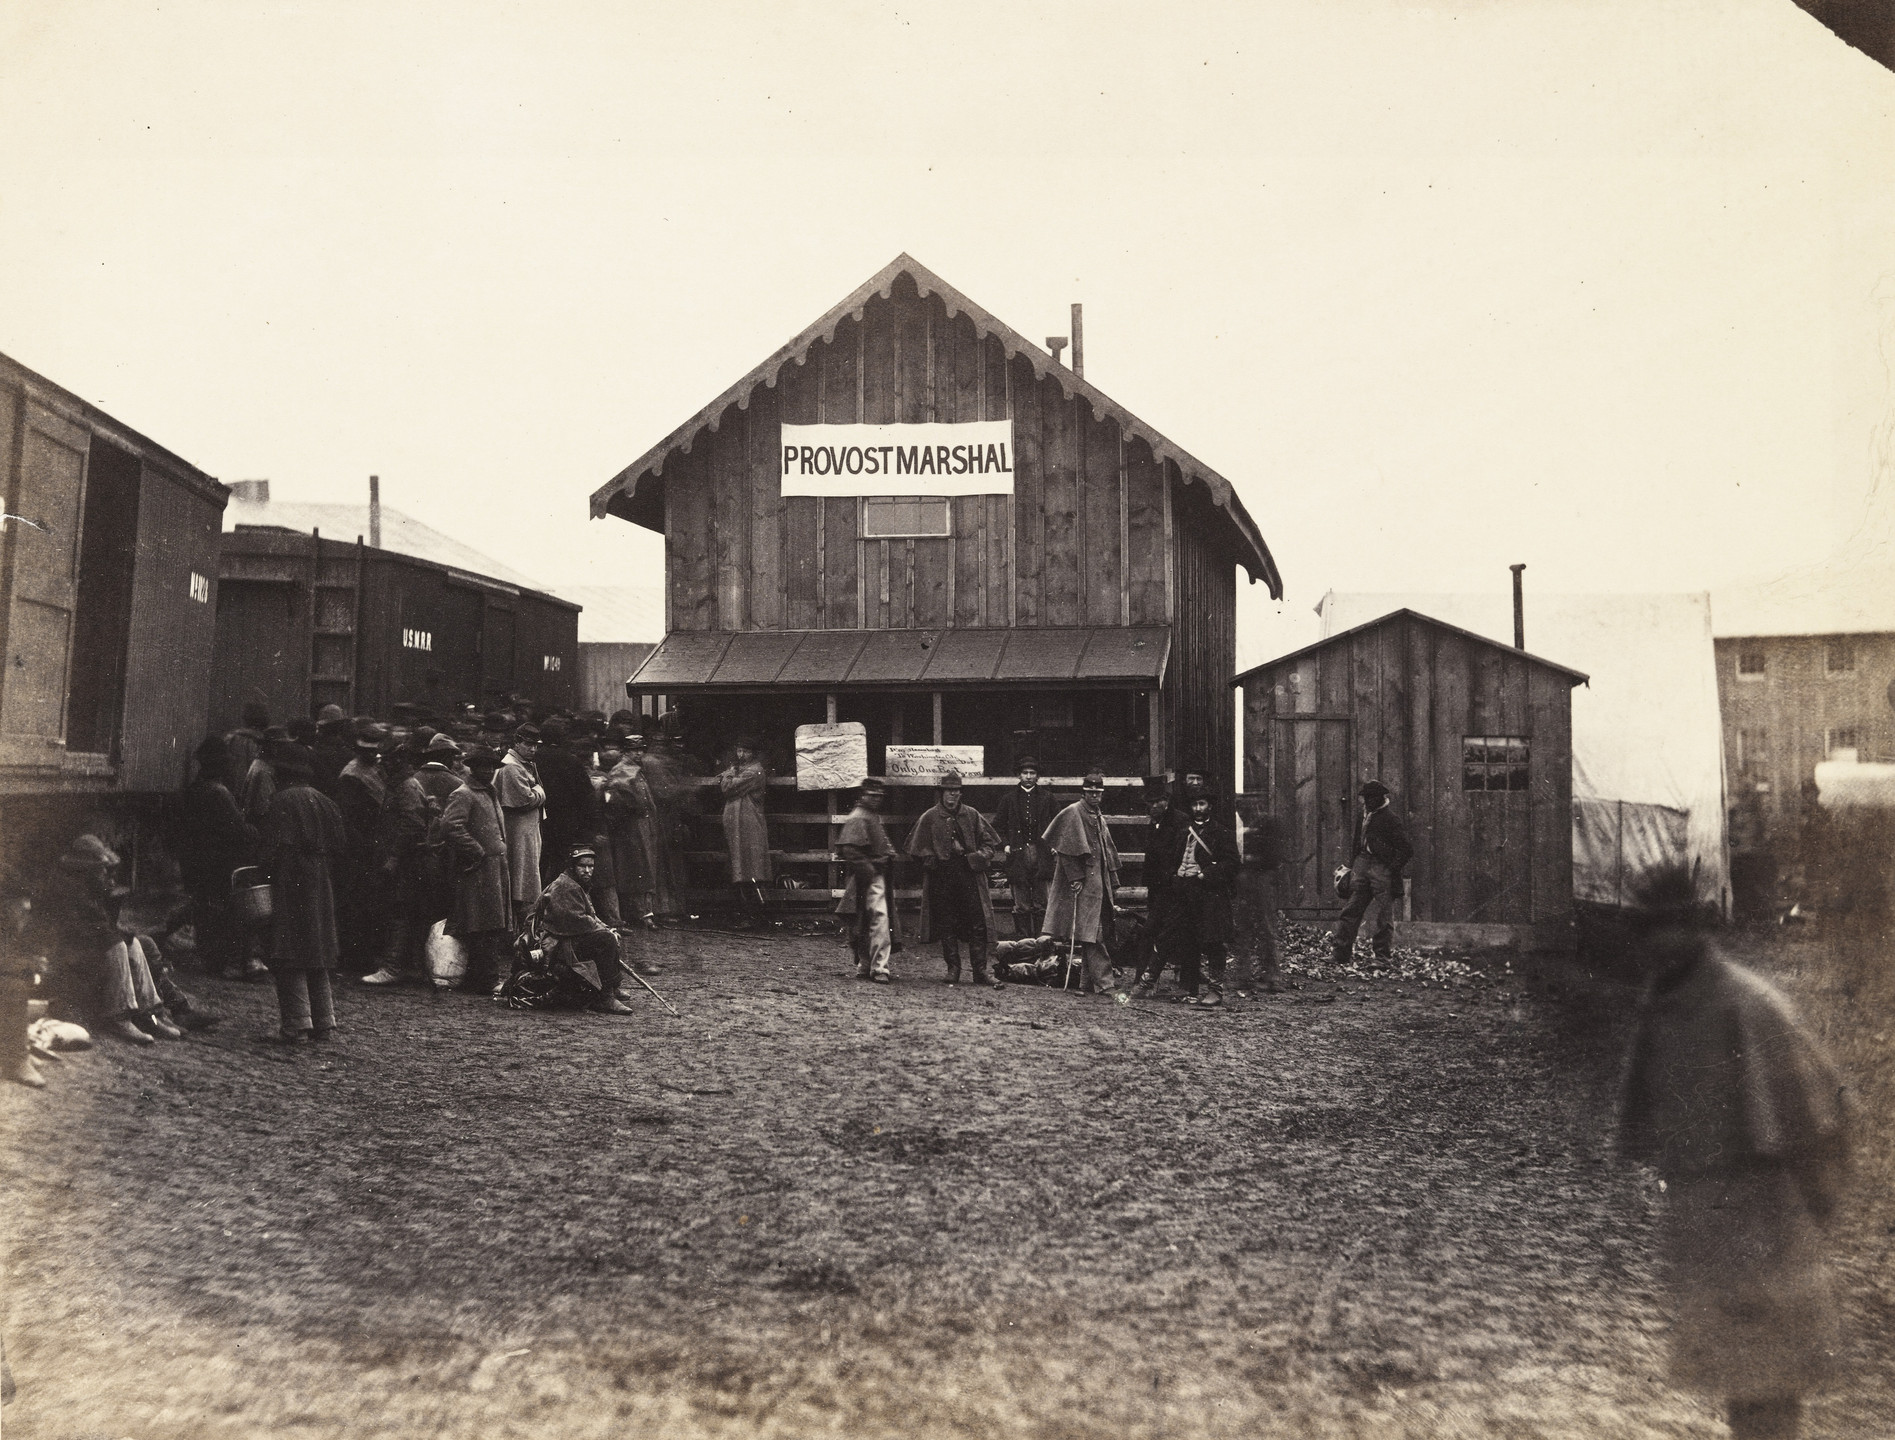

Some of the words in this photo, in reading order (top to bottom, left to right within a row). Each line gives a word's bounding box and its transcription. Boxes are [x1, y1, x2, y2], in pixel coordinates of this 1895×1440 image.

[784, 445, 894, 475] PROVOST
[896, 442, 1013, 475] MARSHAL
[891, 760, 918, 776] Only
[919, 764, 937, 774] One
